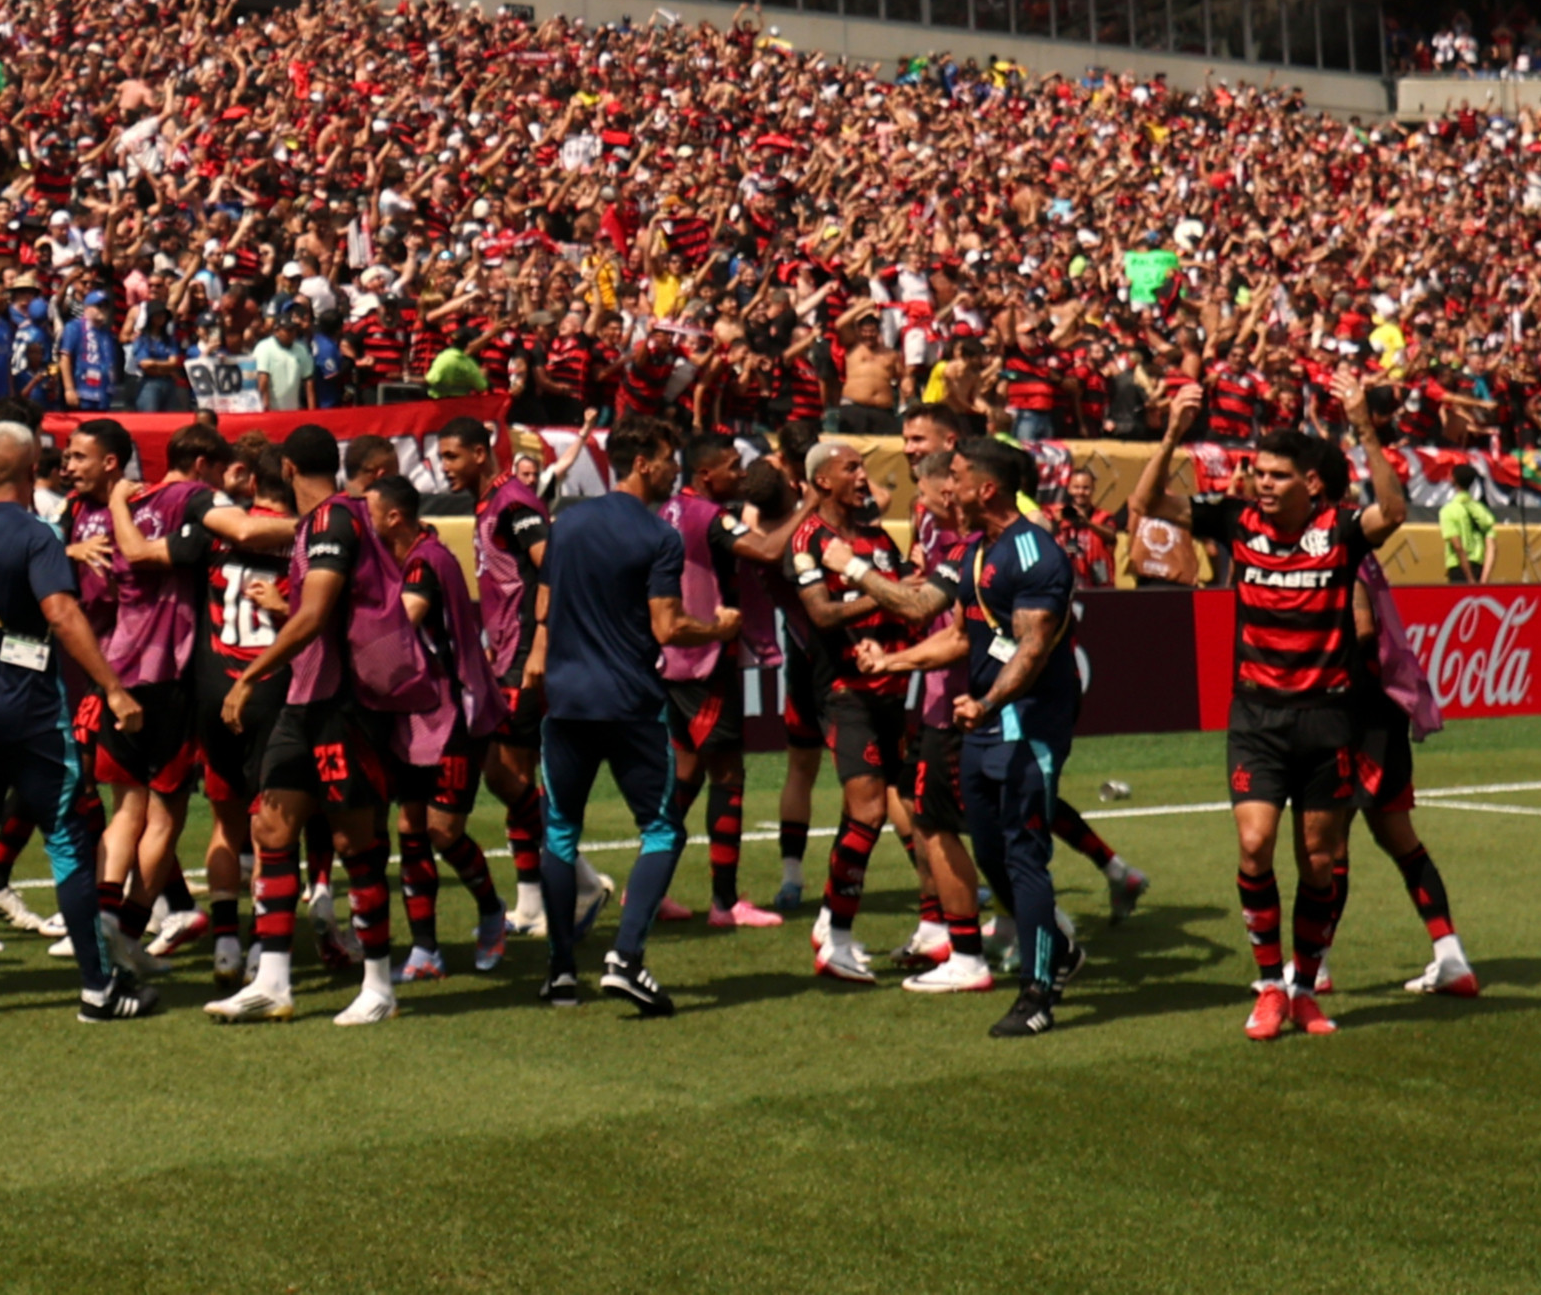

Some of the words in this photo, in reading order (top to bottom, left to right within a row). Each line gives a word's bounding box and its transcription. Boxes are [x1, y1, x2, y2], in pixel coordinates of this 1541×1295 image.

[1244, 568, 1333, 588] FLABET
[1406, 595, 1539, 707] a-Cola
[314, 743, 349, 782] 23
